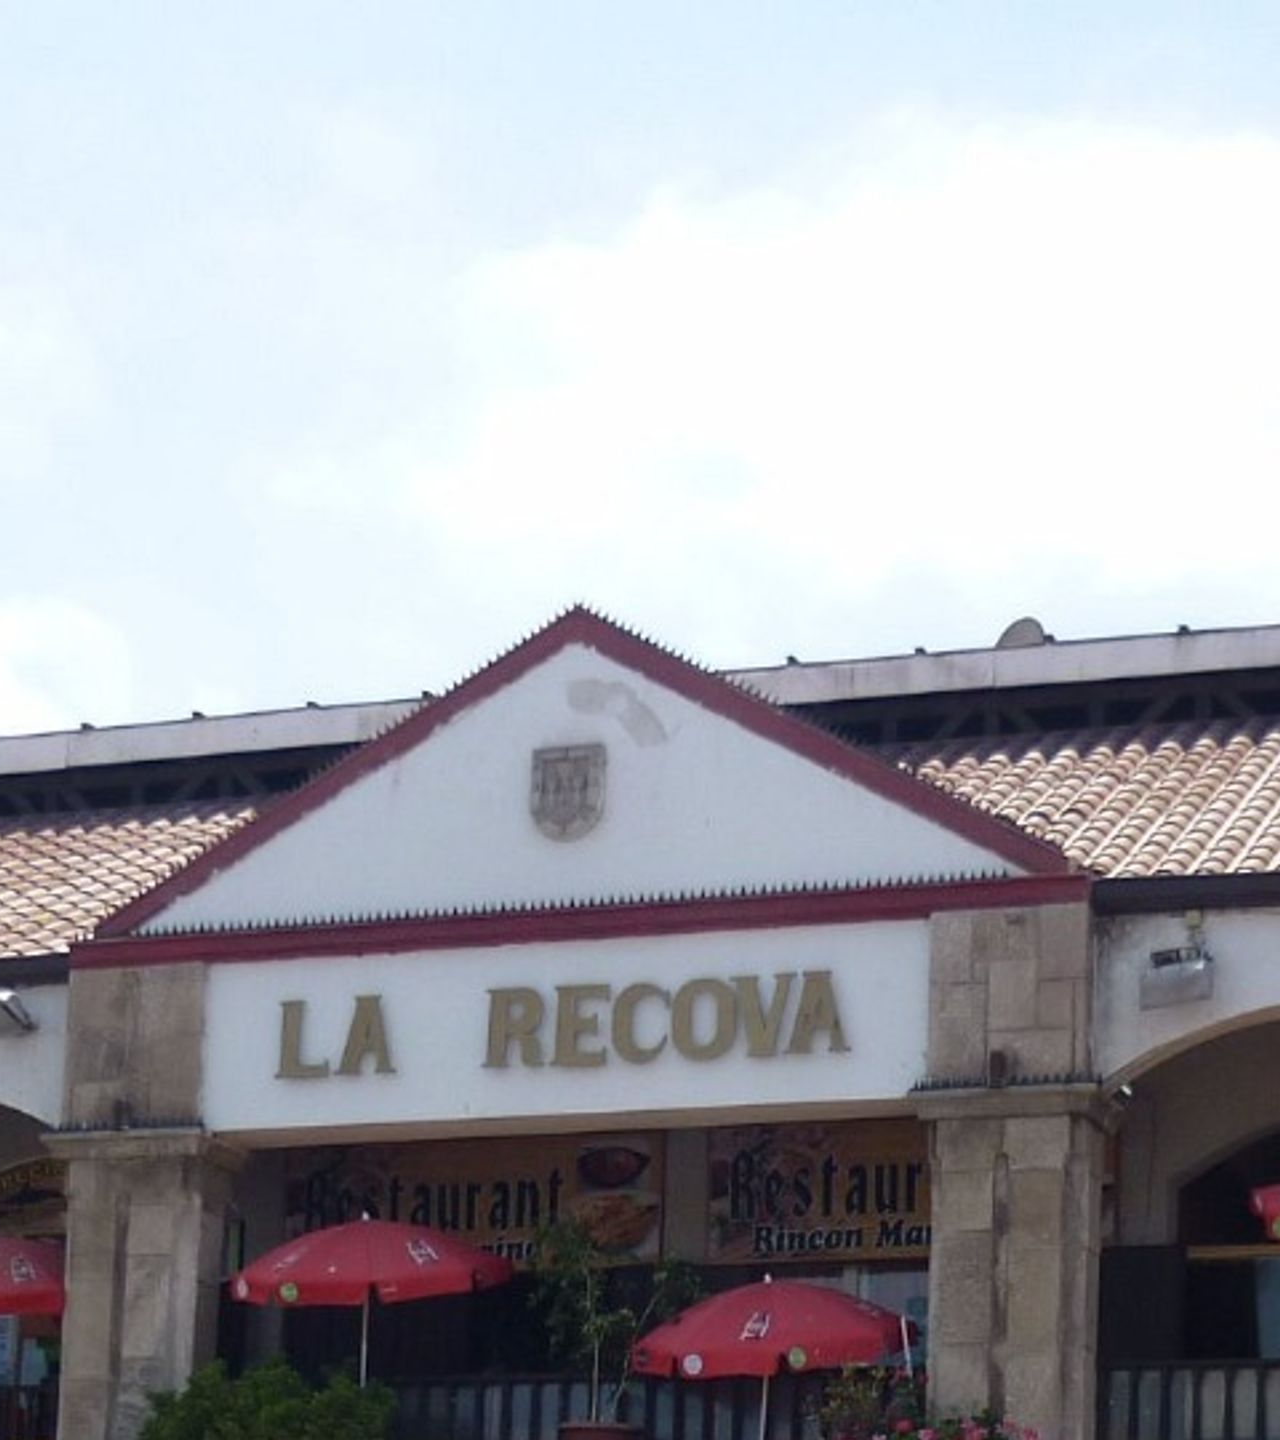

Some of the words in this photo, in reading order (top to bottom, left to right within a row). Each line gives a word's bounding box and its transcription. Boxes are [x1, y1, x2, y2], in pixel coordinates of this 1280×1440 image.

[276, 994, 397, 1080] LA
[483, 969, 851, 1070] RECOVA
[753, 1226, 863, 1258] Rincon
